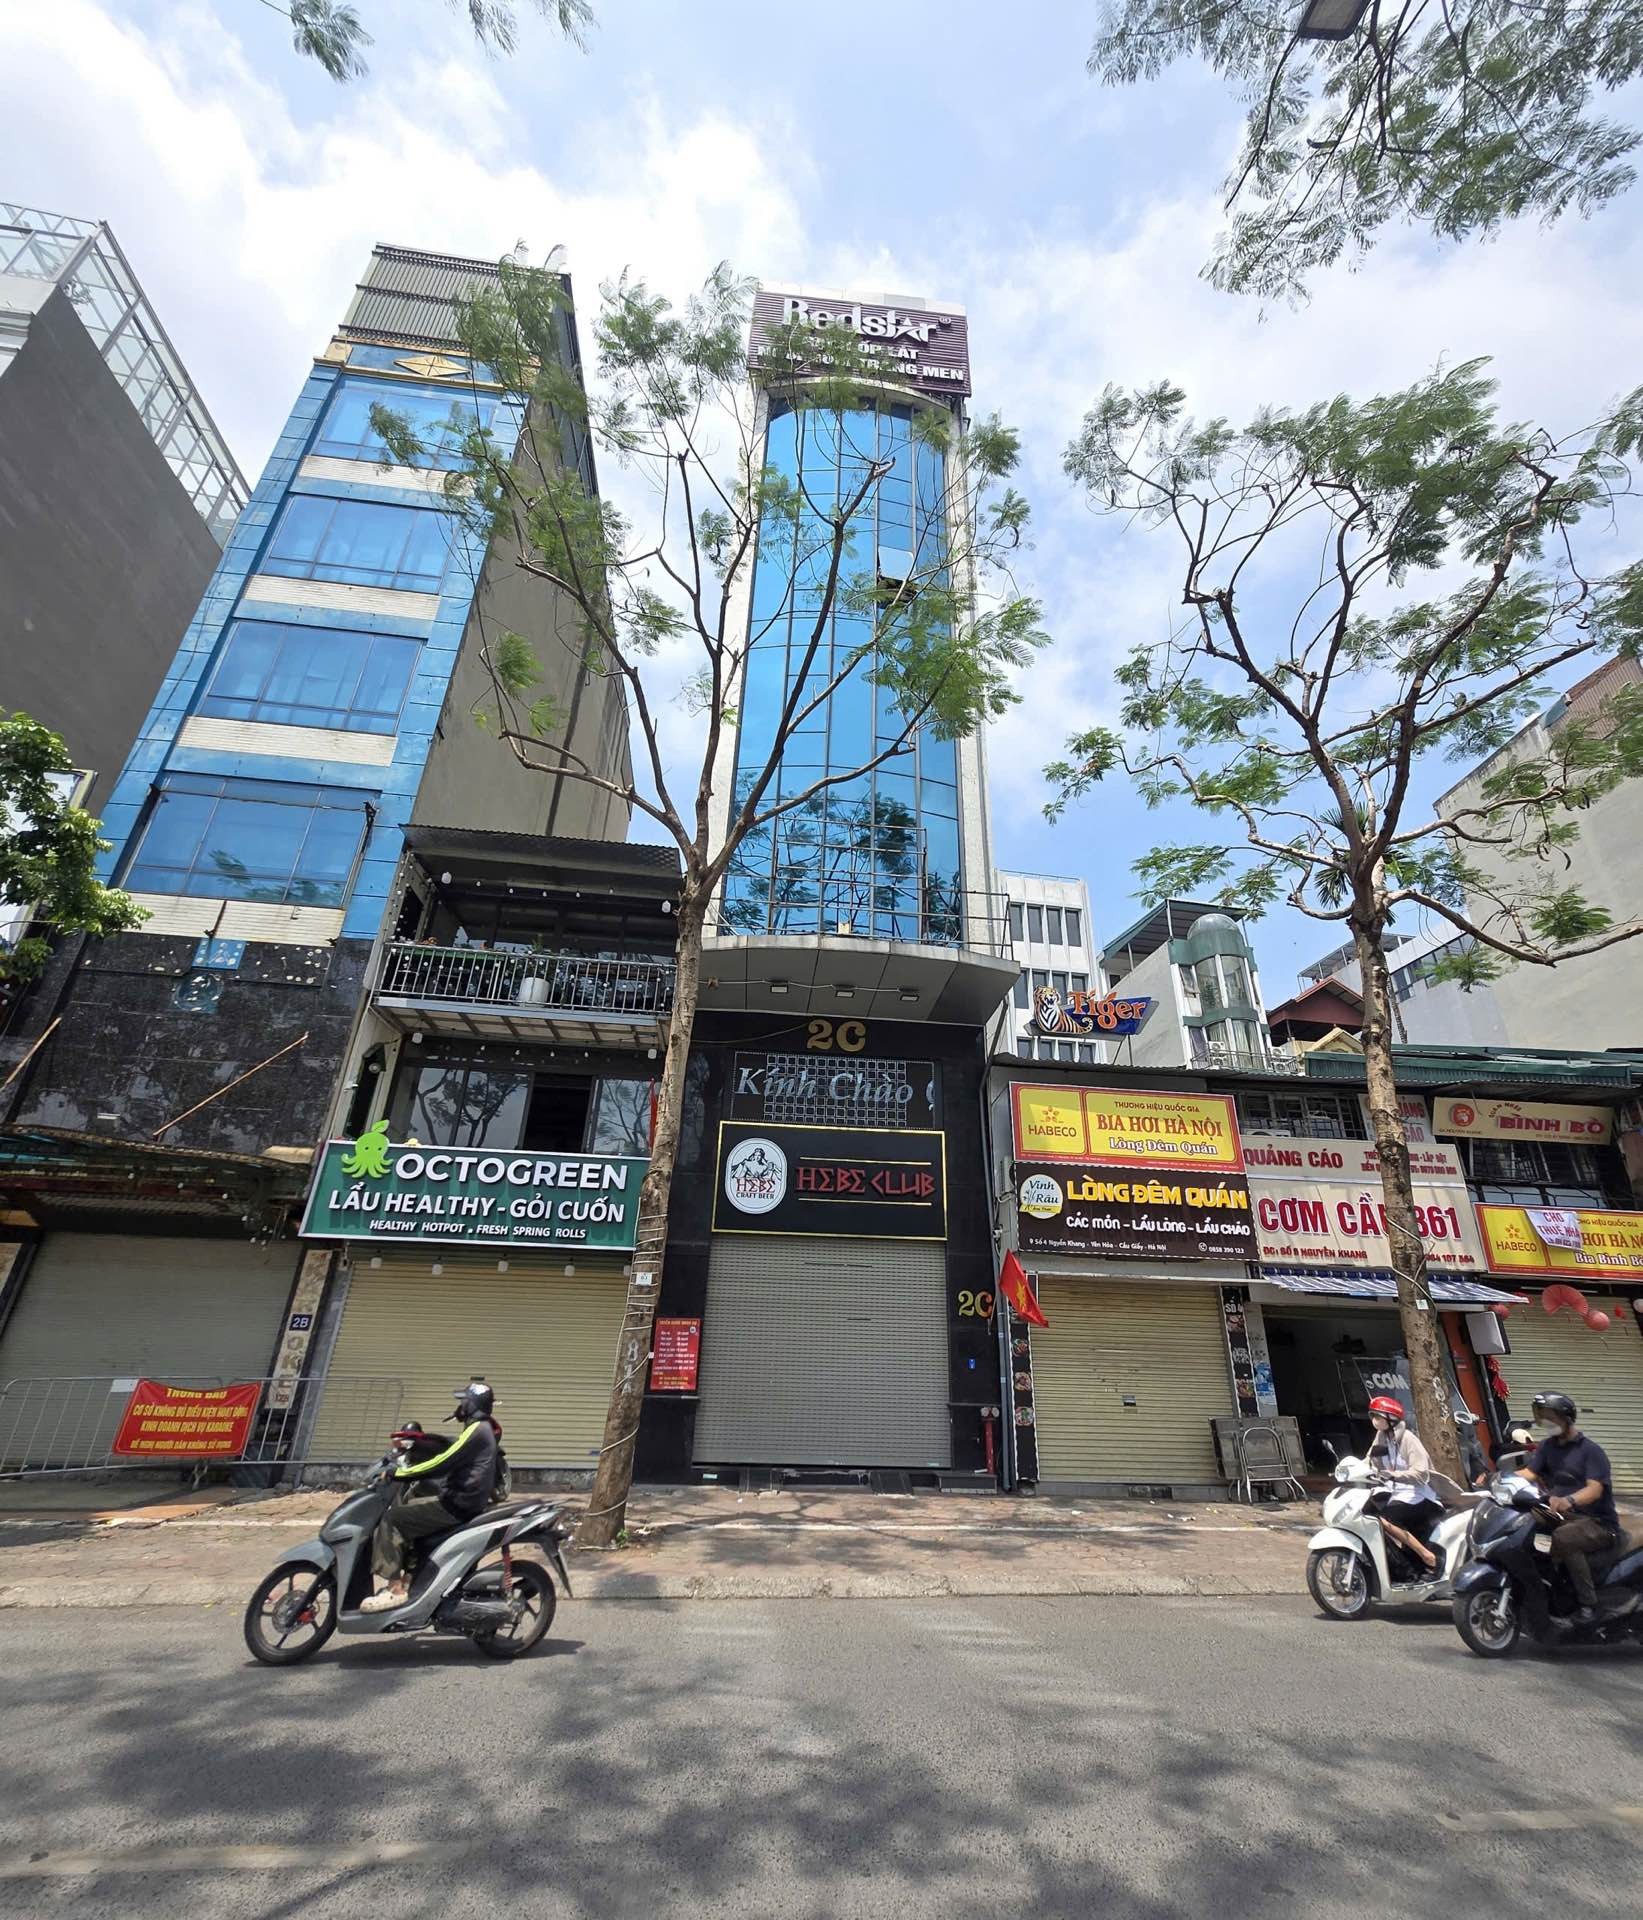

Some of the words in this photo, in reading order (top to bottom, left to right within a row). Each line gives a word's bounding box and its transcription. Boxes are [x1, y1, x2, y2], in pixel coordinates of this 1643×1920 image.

[922, 365, 964, 380] MEN
[1067, 988, 1146, 1030] Tiger
[806, 1019, 866, 1051] 2C
[735, 1066, 817, 1098] Kính
[829, 1072, 913, 1103] Chào
[1028, 1125, 1077, 1138] HABECO
[1097, 1114, 1125, 1131] BIA
[1129, 1115, 1160, 1133] HƠI
[1164, 1114, 1189, 1135] HÀ
[1192, 1117, 1223, 1141] NỘI
[1109, 1137, 1143, 1152] Lòng
[1146, 1140, 1178, 1153] Đêm
[1181, 1140, 1217, 1155] Quán
[1243, 1144, 1303, 1167] QUẢNG
[1307, 1148, 1344, 1169] CÁO
[395, 1153, 627, 1190] OCTOGREEN
[328, 1182, 378, 1211] LẨU
[384, 1192, 495, 1217] HEALTHY
[509, 1193, 551, 1219] GỎI
[557, 1196, 625, 1223] CUỐN
[1067, 1175, 1130, 1202] LÒNG
[1132, 1179, 1182, 1206] ĐÊM
[1185, 1181, 1248, 1209] QUÁN
[1258, 1199, 1329, 1233] CƠM
[1543, 1212, 1564, 1222] CHO
[369, 1220, 416, 1232] HEALTHY
[421, 1222, 465, 1233] HOTPOT
[476, 1224, 508, 1235] FRESH
[513, 1226, 550, 1237] SPRING
[555, 1228, 586, 1238] ROLLS
[1609, 1230, 1630, 1249] HÀ
[1337, 1250, 1368, 1259] KHANG
[1496, 1241, 1537, 1253] HABECO
[1576, 1252, 1596, 1264] Bia
[957, 1289, 993, 1319] 2C
